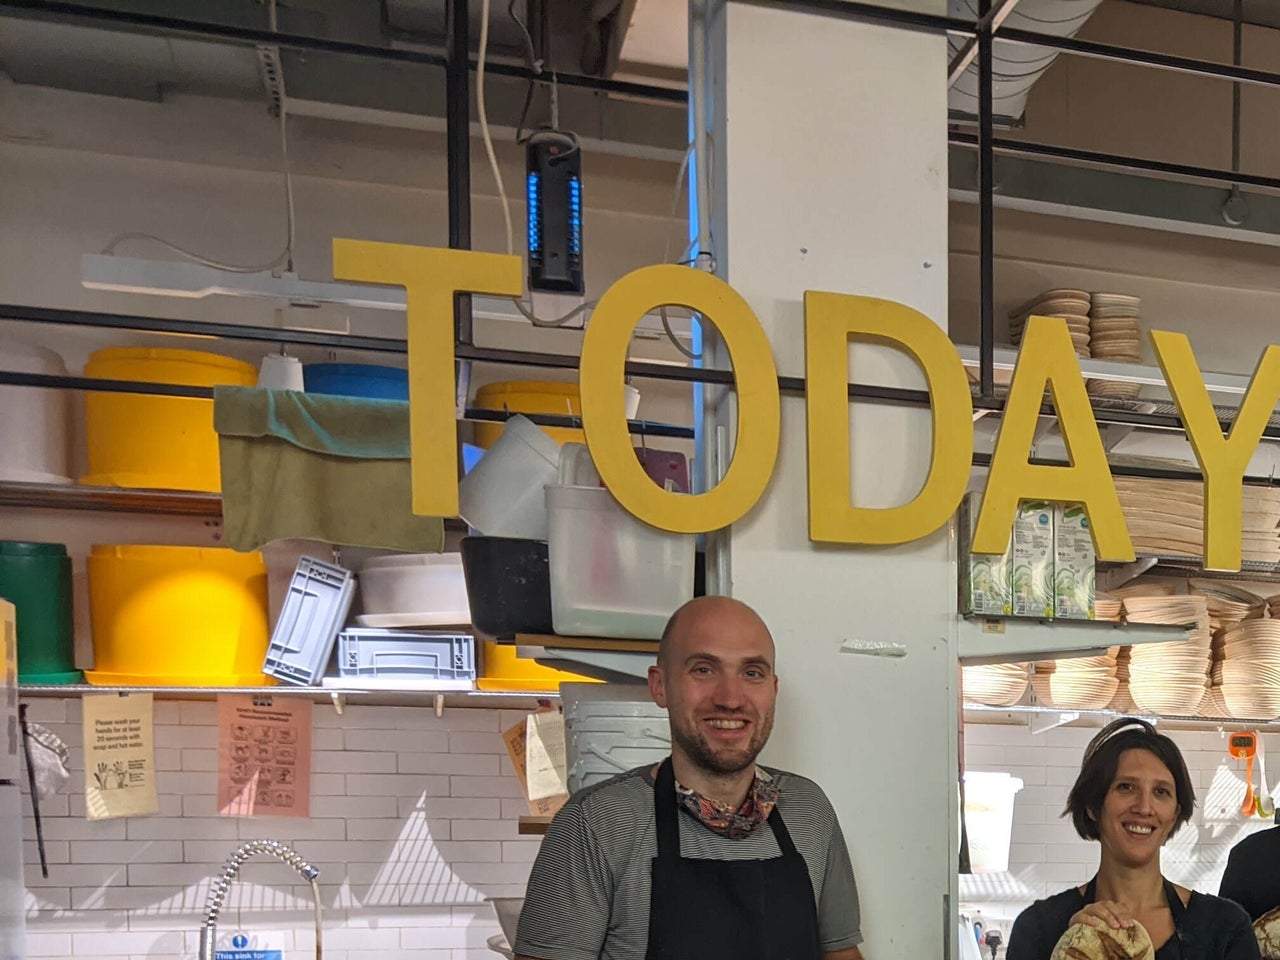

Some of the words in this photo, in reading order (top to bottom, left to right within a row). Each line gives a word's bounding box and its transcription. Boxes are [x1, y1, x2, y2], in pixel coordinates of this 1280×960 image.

[215, 952, 234, 960] This
[235, 952, 251, 960] sink
[253, 952, 265, 960] for
